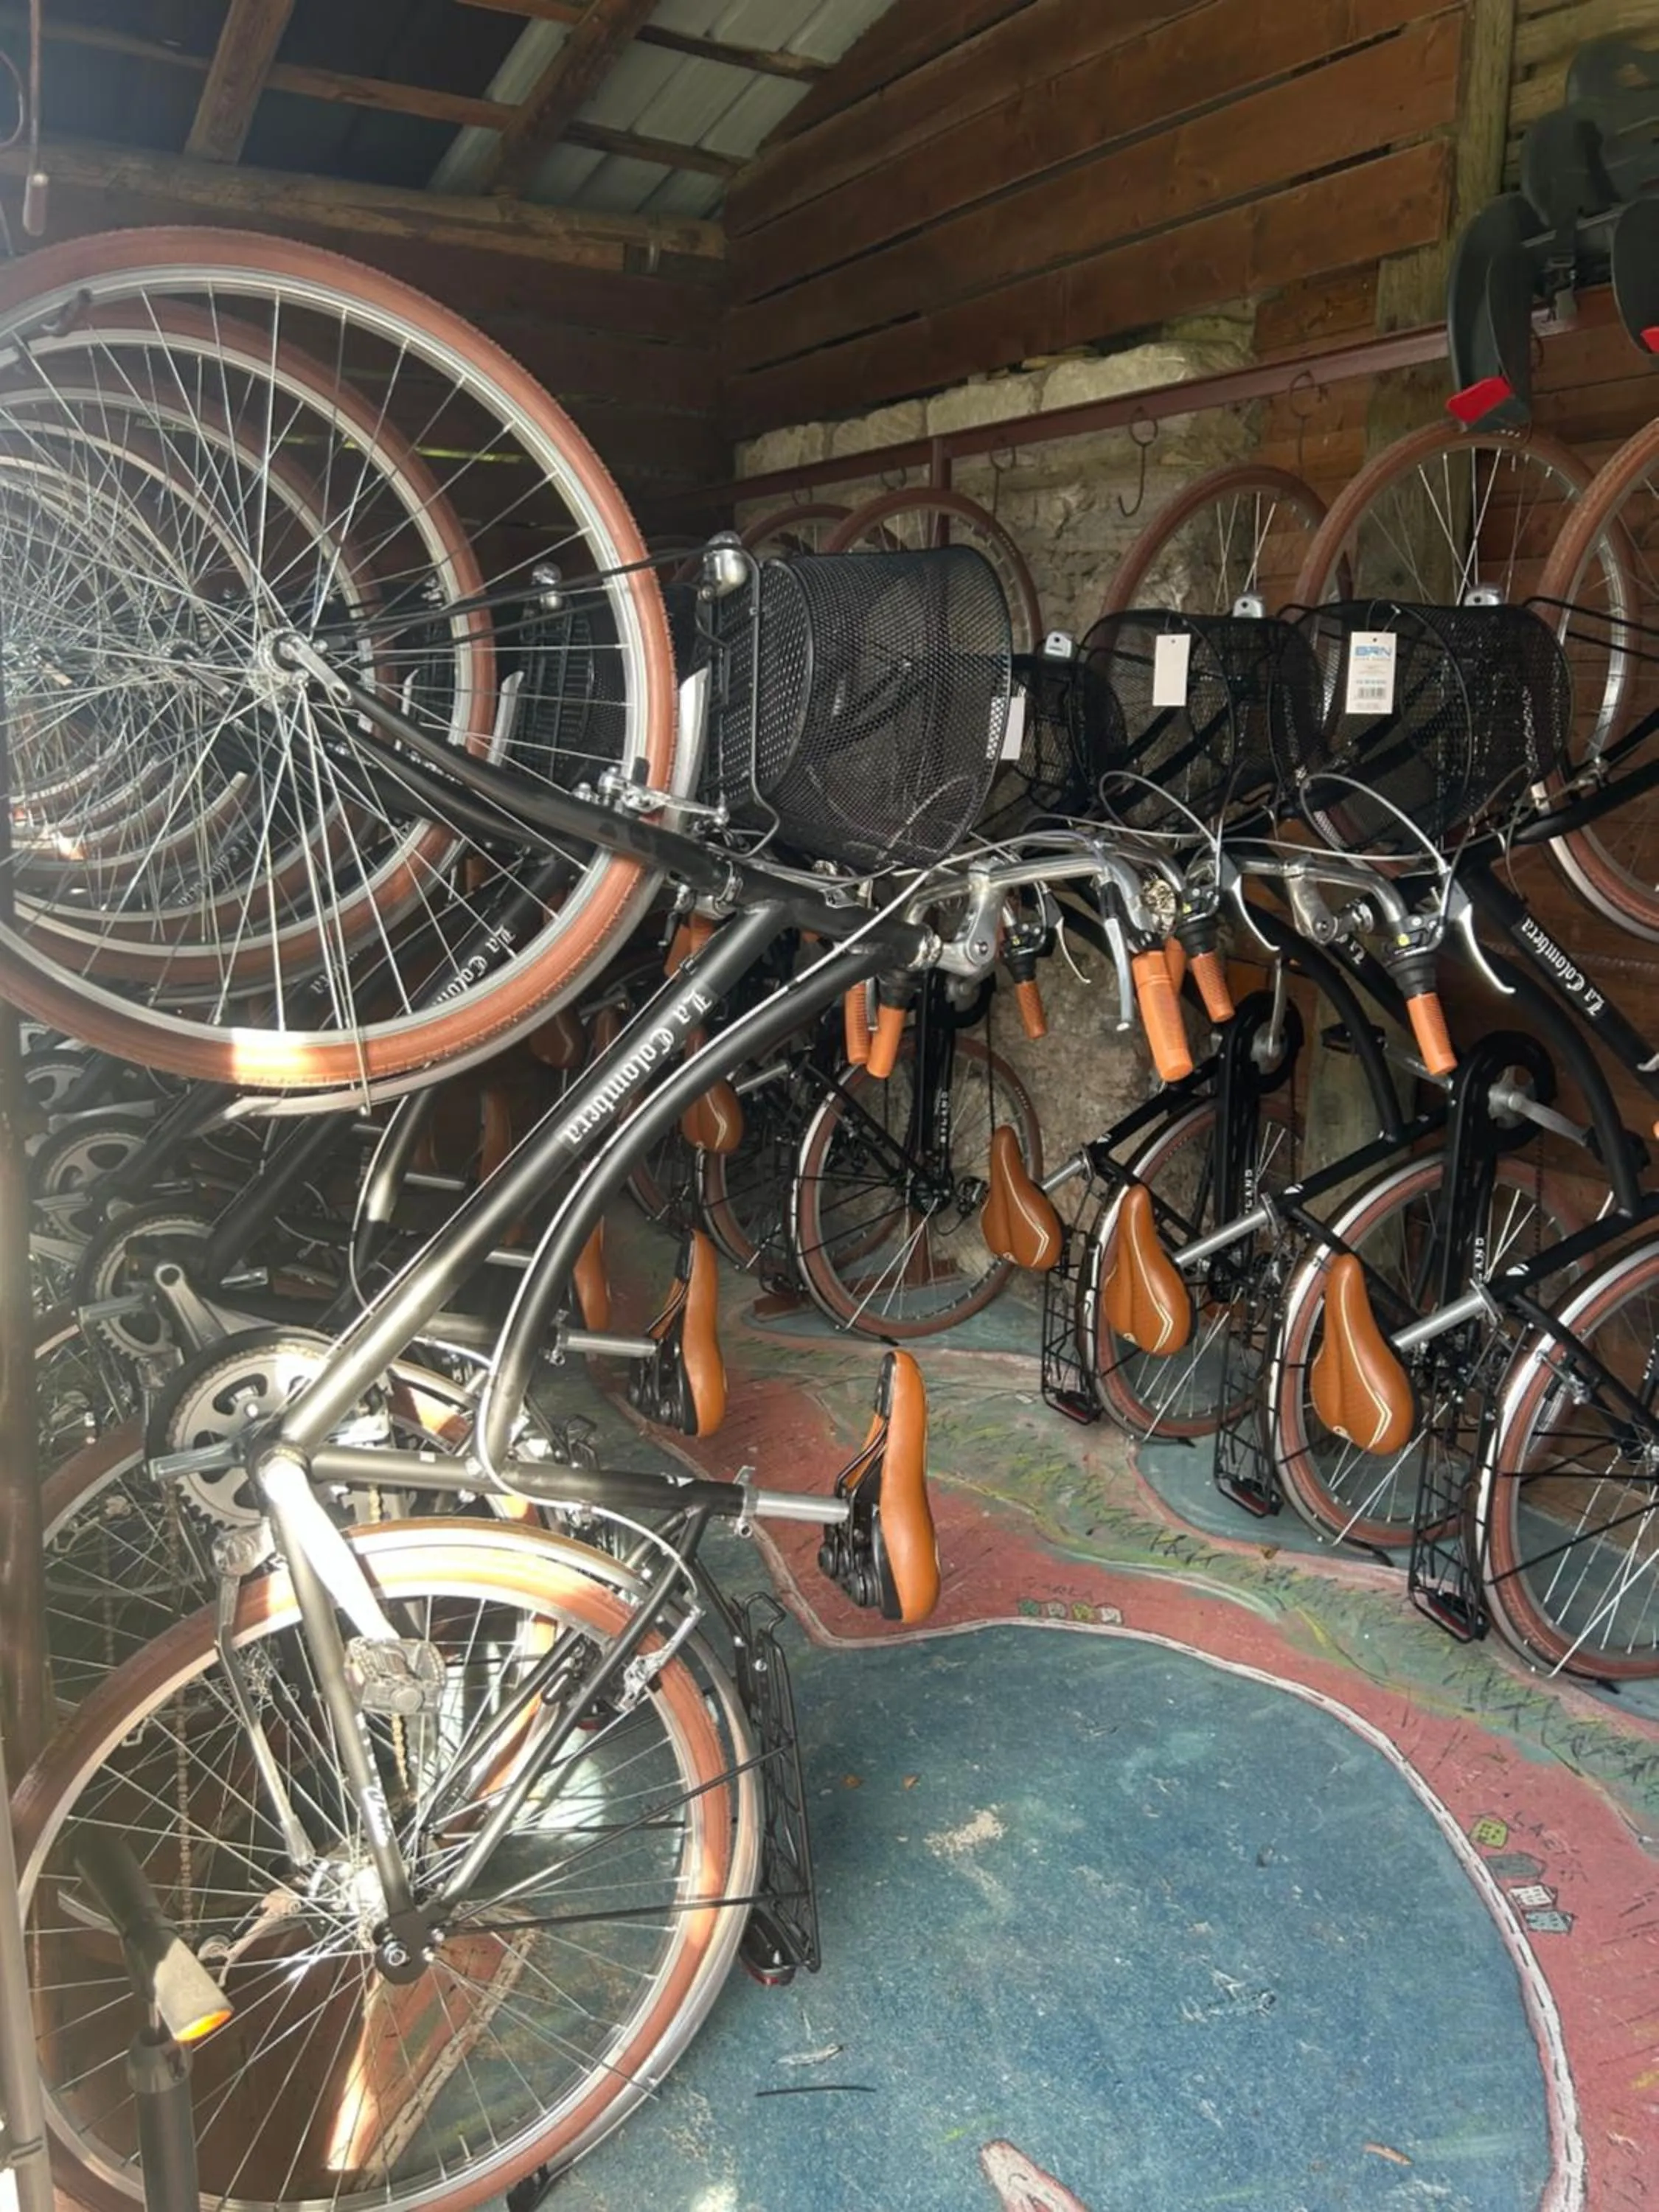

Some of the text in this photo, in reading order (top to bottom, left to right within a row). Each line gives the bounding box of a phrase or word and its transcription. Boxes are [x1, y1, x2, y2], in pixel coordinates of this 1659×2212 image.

[1521, 918, 1605, 1017] La Colombera
[563, 989, 712, 1144] La Colombera
